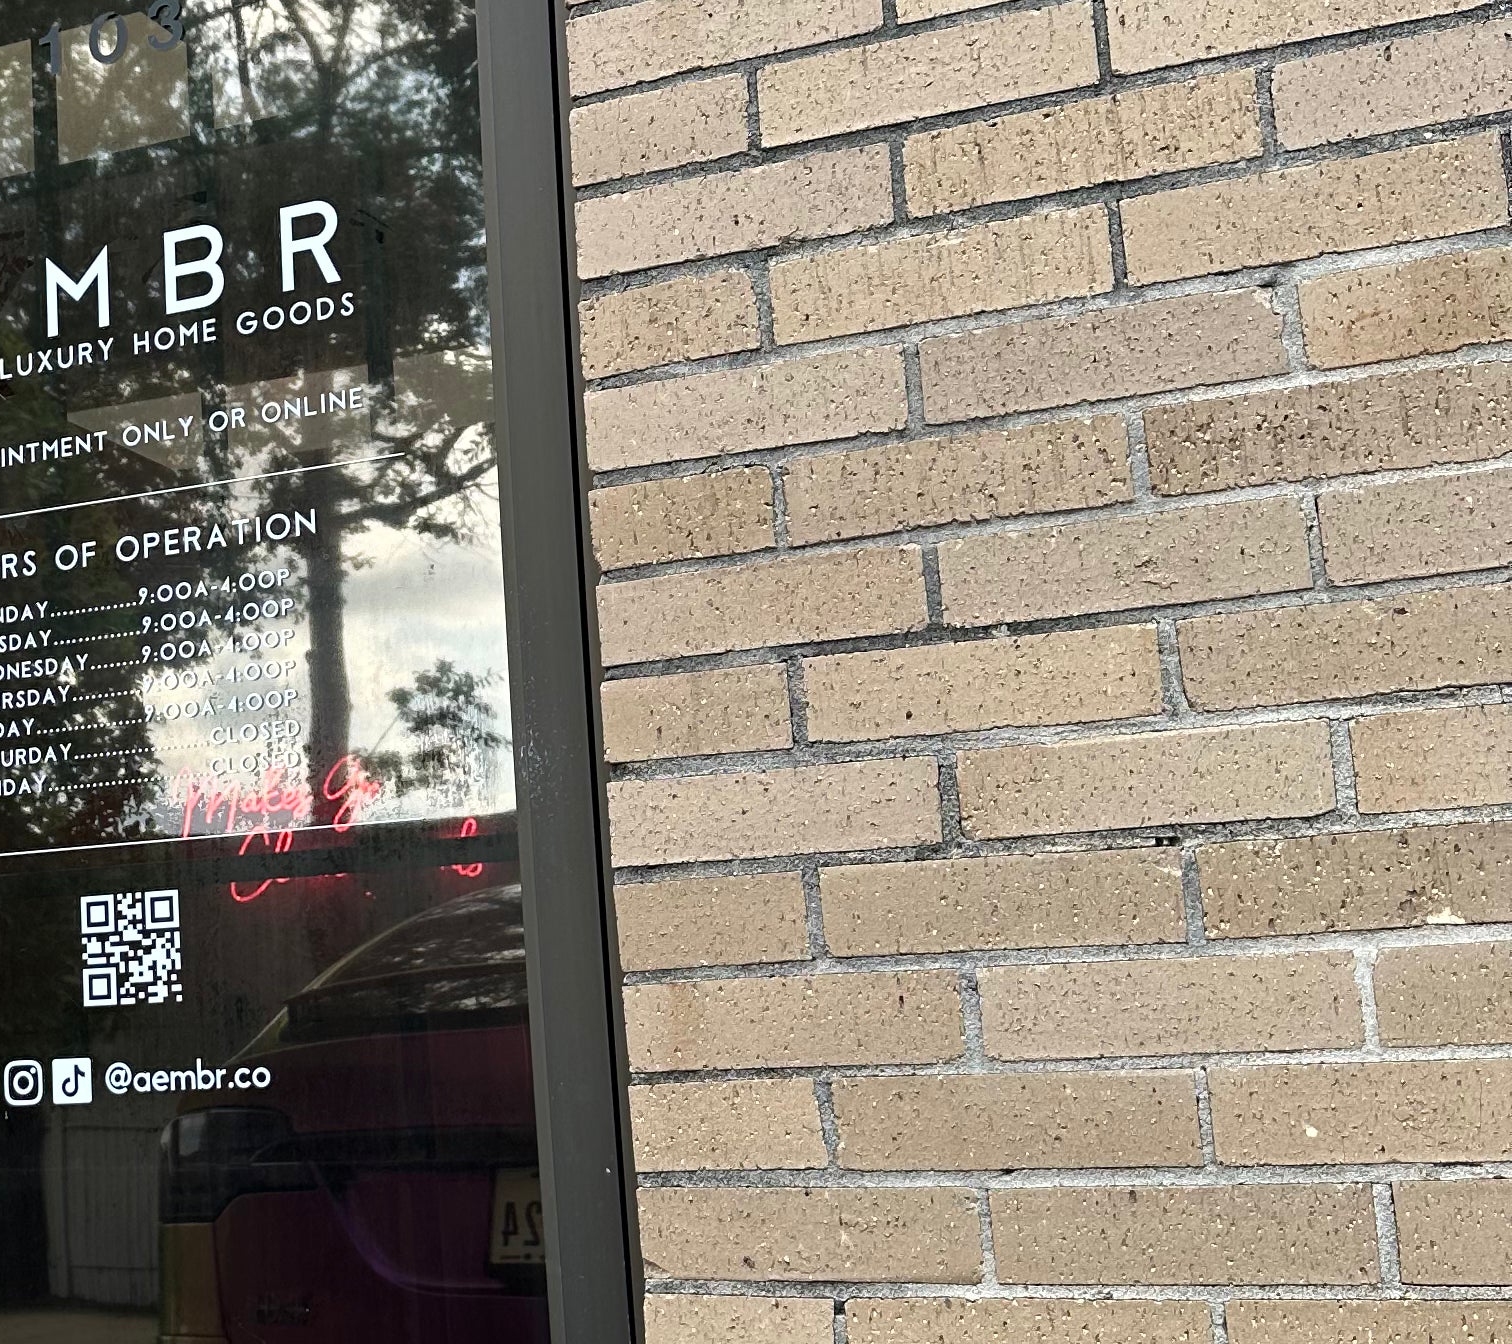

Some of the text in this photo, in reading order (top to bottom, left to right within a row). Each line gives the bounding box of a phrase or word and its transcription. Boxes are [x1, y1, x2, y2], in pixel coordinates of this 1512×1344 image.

[132, 317, 218, 356] HOME
[236, 292, 356, 336] GOODS
[121, 416, 195, 446] ONLY
[208, 406, 247, 433] OR
[260, 387, 364, 424] ONLINE
[54, 539, 97, 572] OF
[114, 508, 319, 562] OPERATION
[209, 718, 302, 746] CLOSED
[104, 1057, 271, 1095] @aembr.co
